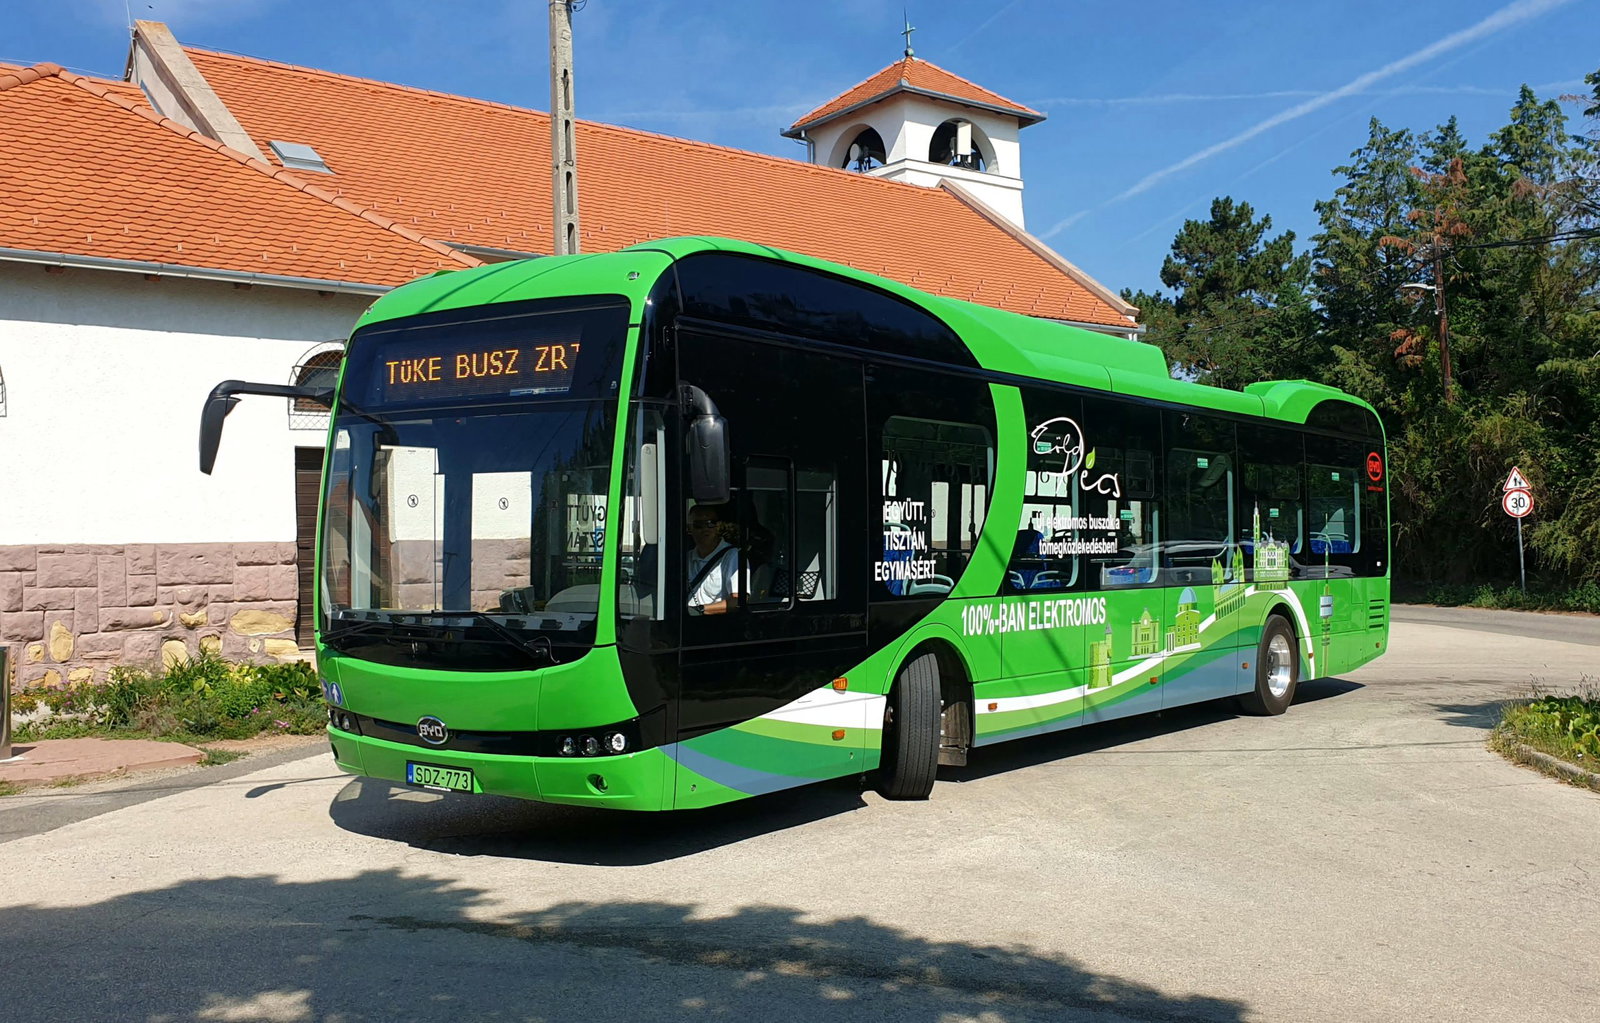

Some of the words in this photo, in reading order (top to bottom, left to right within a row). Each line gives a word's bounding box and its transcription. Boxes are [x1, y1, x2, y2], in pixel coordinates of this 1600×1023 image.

[456, 350, 519, 378] BUSZ
[884, 498, 927, 524] EGYÜTT,
[1511, 497, 1525, 508] 30
[1046, 514, 1088, 530] elektromos
[1088, 513, 1115, 530] buszok
[884, 527, 928, 553] TISZTÁN,
[1039, 538, 1118, 559] tömegközlekedésben!
[874, 556, 937, 581] EGYMÁSÉRT
[961, 603, 1025, 637] 100%-BAN
[1028, 597, 1106, 630] ELEKTROMOS
[419, 724, 443, 737] BYD
[415, 767, 469, 789] SDZ-773
